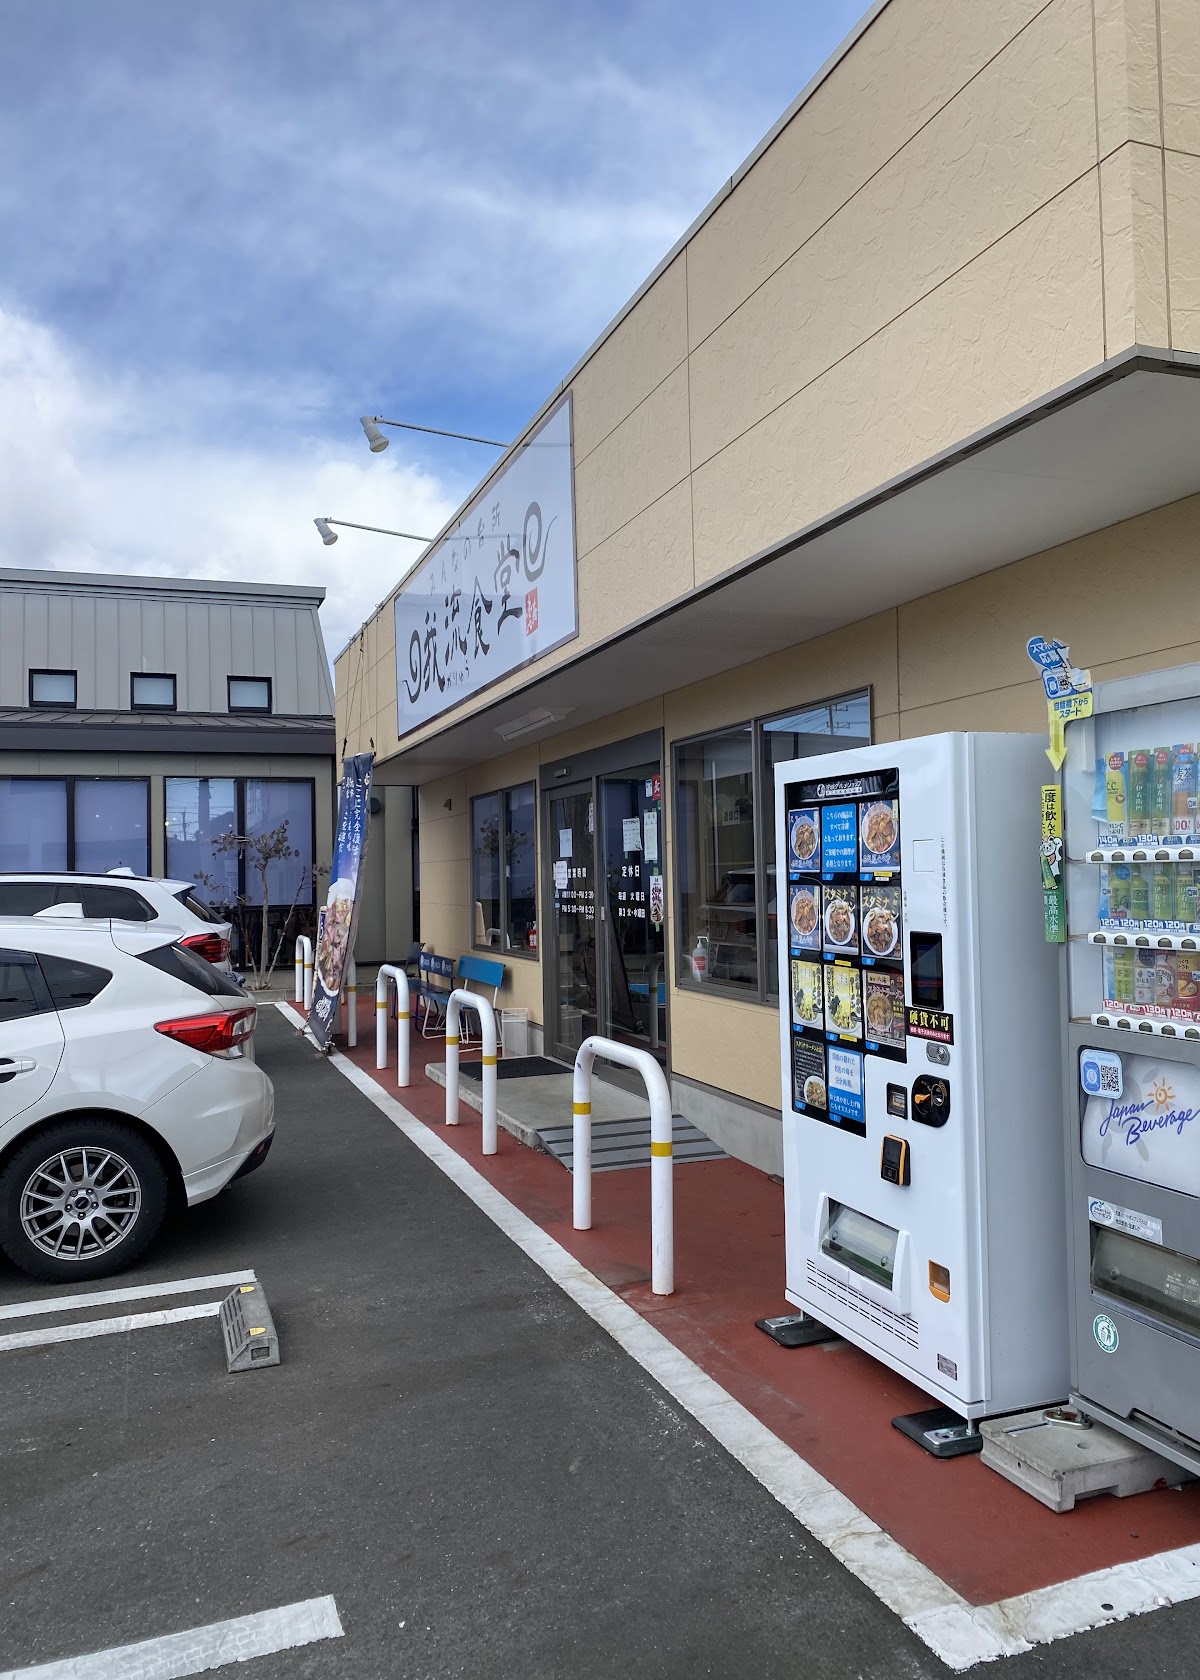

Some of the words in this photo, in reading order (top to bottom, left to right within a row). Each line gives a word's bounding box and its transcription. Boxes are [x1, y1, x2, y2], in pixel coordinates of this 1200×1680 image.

[1053, 697, 1089, 711] 自販機下から
[1059, 707, 1082, 719] スタート
[1176, 767, 1192, 782] 麦茶
[1044, 789, 1057, 835] 一度は飲んで
[621, 865, 640, 877] 定休日
[862, 895, 890, 909] スタミナ
[909, 1009, 950, 1031] 硬貨不可
[1100, 1100, 1154, 1137] Japan
[1122, 1108, 1200, 1146] Beverage
